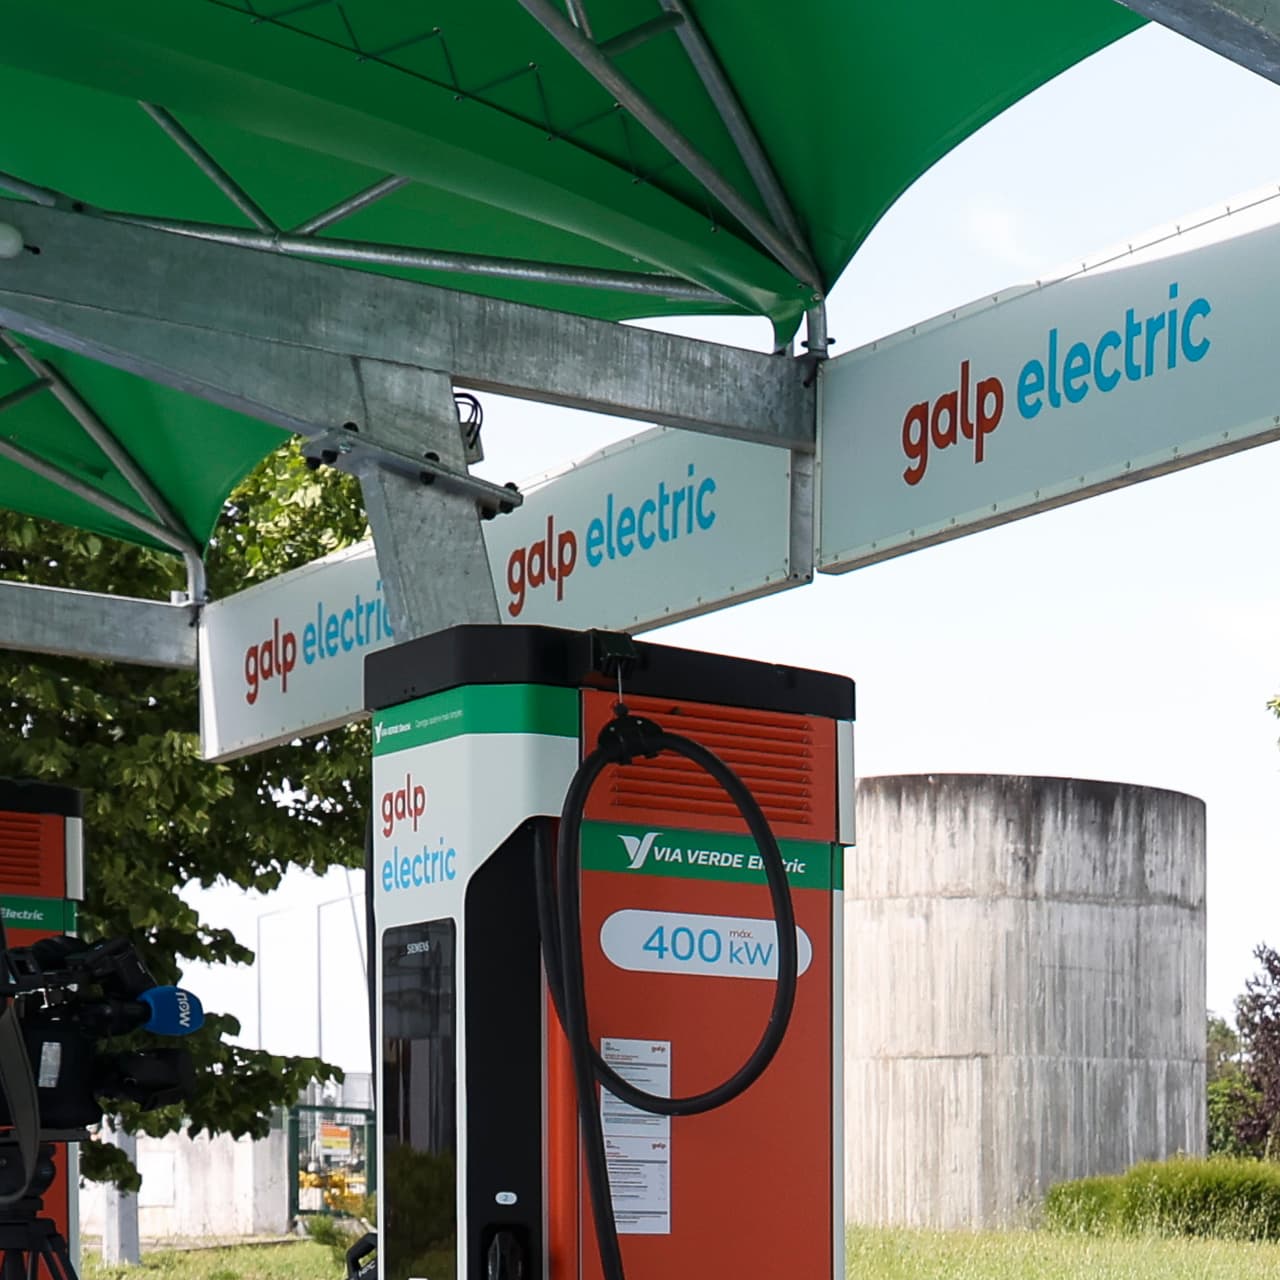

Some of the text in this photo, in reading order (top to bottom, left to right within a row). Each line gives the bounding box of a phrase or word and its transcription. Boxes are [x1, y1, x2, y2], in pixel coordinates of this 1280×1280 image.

[902, 282, 1211, 486] galp electric
[507, 463, 716, 617] galp electric
[244, 618, 296, 705] galp
[382, 773, 425, 838] galp
[382, 837, 456, 892] electric
[653, 846, 683, 863] VIA
[687, 849, 744, 869] VERDE
[642, 925, 774, 966] 400 kW
